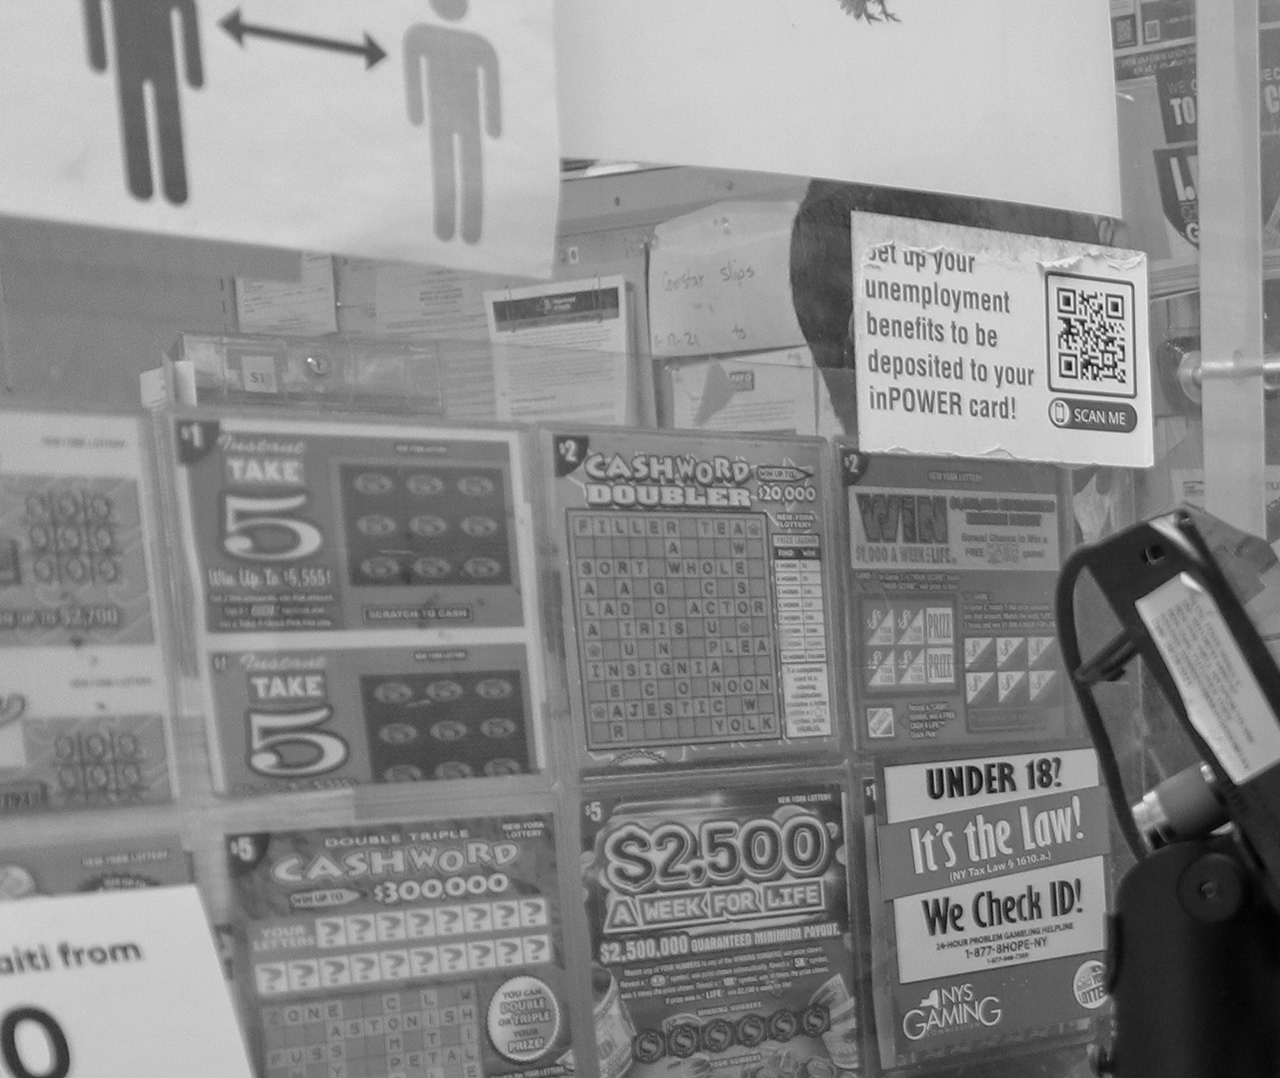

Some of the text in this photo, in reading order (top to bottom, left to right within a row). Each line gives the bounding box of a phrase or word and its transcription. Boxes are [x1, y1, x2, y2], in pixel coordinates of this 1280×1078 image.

[903, 250, 927, 274] up
[933, 250, 976, 275] your
[865, 279, 1010, 314] unemployment
[866, 311, 998, 348] benefits to be
[867, 349, 1035, 388] deposited to your
[869, 386, 1017, 421] inPOWER card!
[1073, 408, 1127, 426] SCAN ME
[558, 439, 579, 463] $2
[843, 455, 859, 473] $2
[226, 457, 300, 483] TAKE
[584, 453, 750, 486] CASHWORD
[586, 482, 751, 507] DOUBLER
[757, 484, 817, 503] $20,000
[224, 494, 323, 562] 5
[251, 674, 324, 699] TAKE
[250, 706, 347, 777] 5
[925, 756, 1063, 800] UNDER 18?
[584, 801, 602, 822] $5
[324, 828, 470, 848] DOUBLE TRIPLE
[909, 794, 1085, 875] It’s the Law!
[272, 841, 519, 882] CASHWORD
[604, 813, 827, 893] $2,500
[949, 869, 967, 883] (NY
[968, 865, 985, 878] Tax
[986, 861, 1006, 874] Law
[373, 872, 509, 904] $300,000
[613, 885, 819, 925] A WEEK FOR LIFE
[920, 877, 1084, 937] We Check ID!
[690, 929, 752, 952] GUARANTEED
[754, 925, 802, 945] MINIMUM
[936, 921, 1075, 951] 24-HOUR PROBLEM GAMBLING HELPLINE
[964, 936, 1049, 960] 1-877-8HOPE-NY
[57, 940, 142, 970] from
[502, 988, 542, 998] YOU CAN
[941, 983, 974, 1005] NYS
[513, 1011, 550, 1025] TRIPLE
[902, 995, 1002, 1040] GAMING
